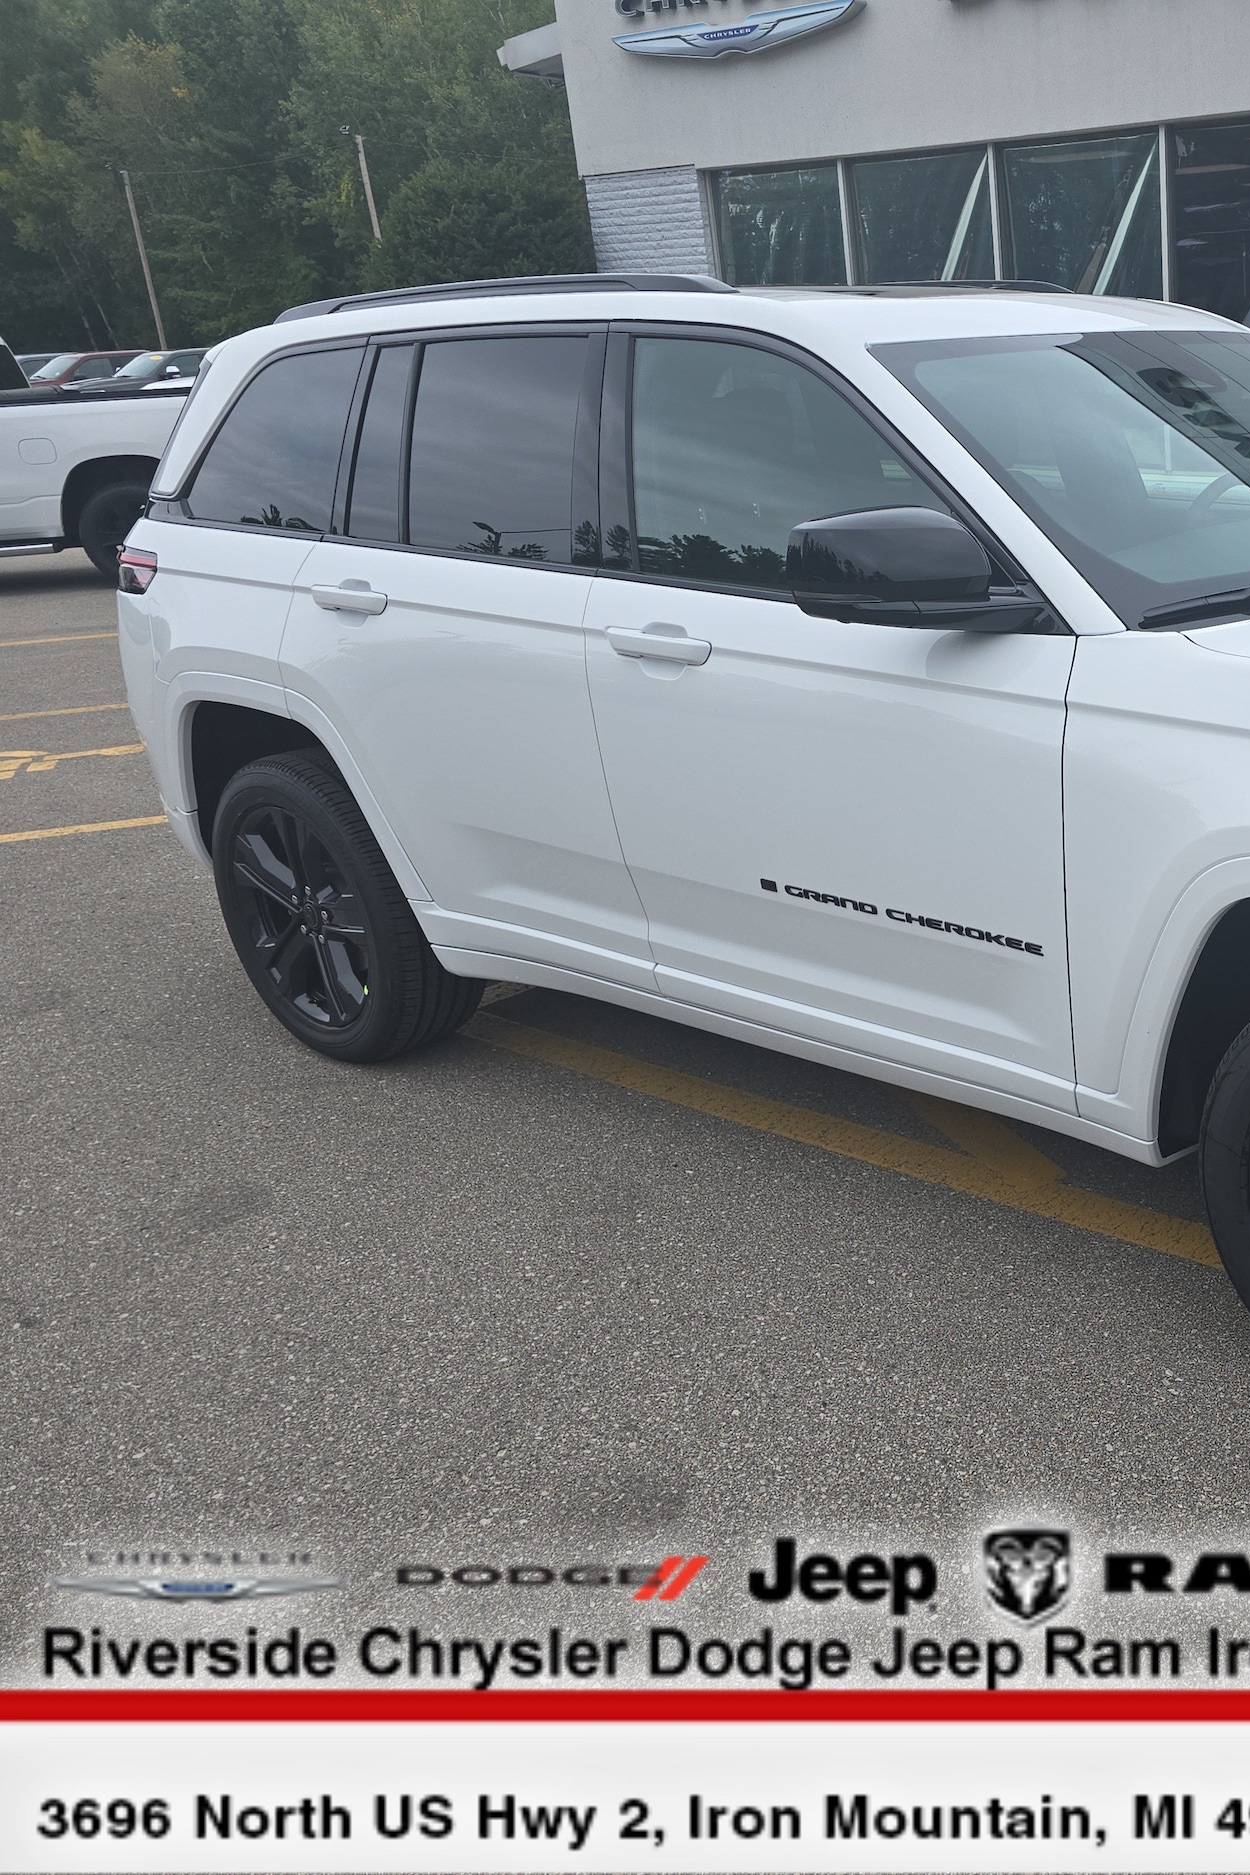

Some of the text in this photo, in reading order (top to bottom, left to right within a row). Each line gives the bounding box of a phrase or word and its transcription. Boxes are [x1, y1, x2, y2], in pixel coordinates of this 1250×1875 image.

[704, 28, 751, 39] CHRYSLER
[784, 885, 1044, 956] GRAND CHEROKEE
